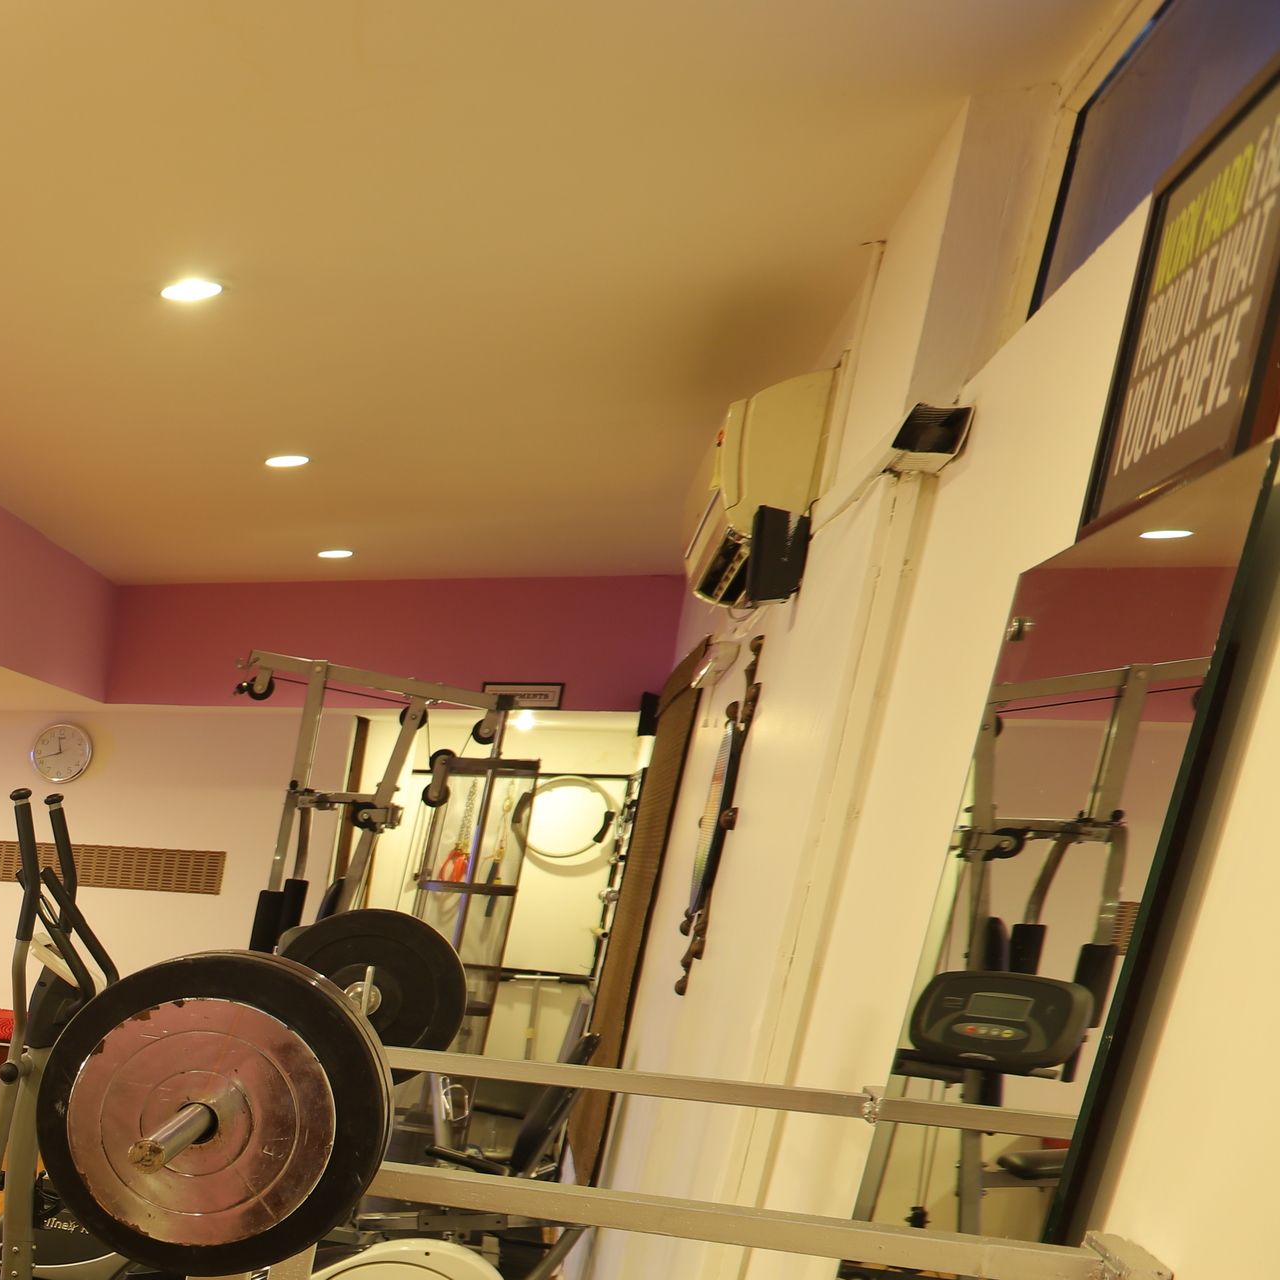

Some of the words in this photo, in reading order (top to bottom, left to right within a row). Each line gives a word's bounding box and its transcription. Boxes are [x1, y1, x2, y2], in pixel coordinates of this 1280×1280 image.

[1133, 267, 1193, 378] PROUD
[1184, 244, 1219, 338] OF
[1207, 193, 1277, 319] WHAT
[1153, 193, 1201, 295] WORK
[1195, 142, 1255, 258] HARD
[1114, 366, 1162, 476] YOU
[1146, 295, 1253, 455] ACHIEVE
